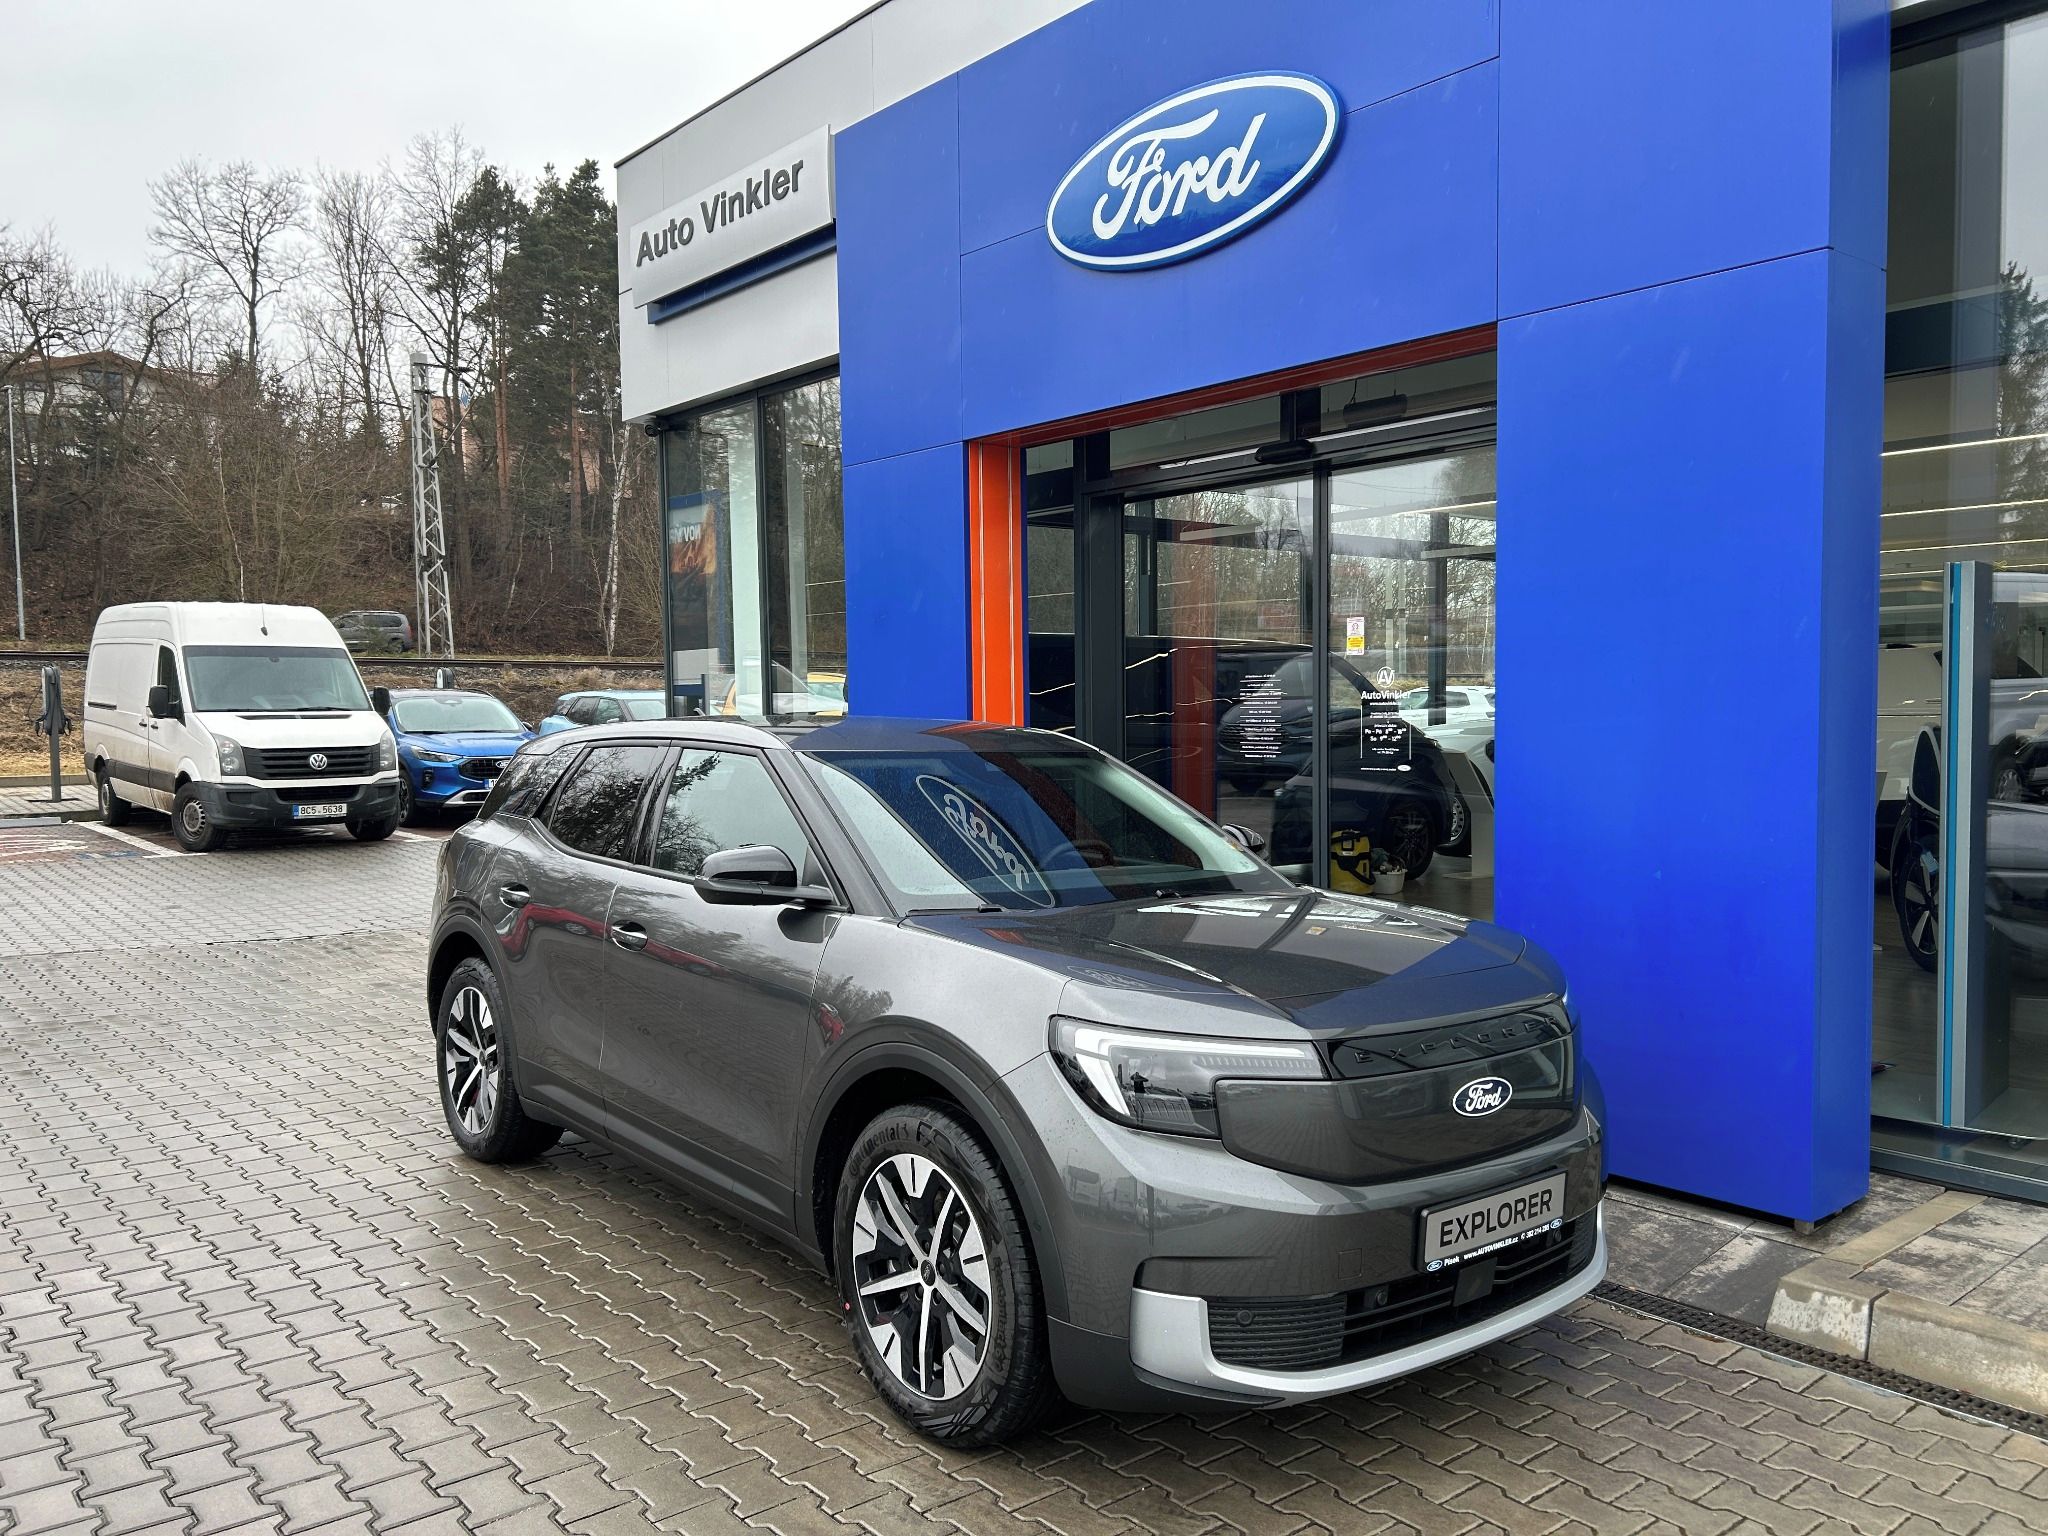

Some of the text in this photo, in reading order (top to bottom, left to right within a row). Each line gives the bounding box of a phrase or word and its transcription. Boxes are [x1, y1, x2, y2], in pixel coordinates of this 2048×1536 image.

[1092, 108, 1267, 240] Ford
[636, 159, 804, 268] Auto Vinkler
[1361, 690, 1411, 700] AutoVinkler
[301, 806, 317, 815] 8C5
[322, 805, 343, 814] 5638
[1354, 1015, 1559, 1064] EXPLORER
[1465, 1082, 1502, 1112] Ford
[1439, 1188, 1553, 1248] EXPLORER
